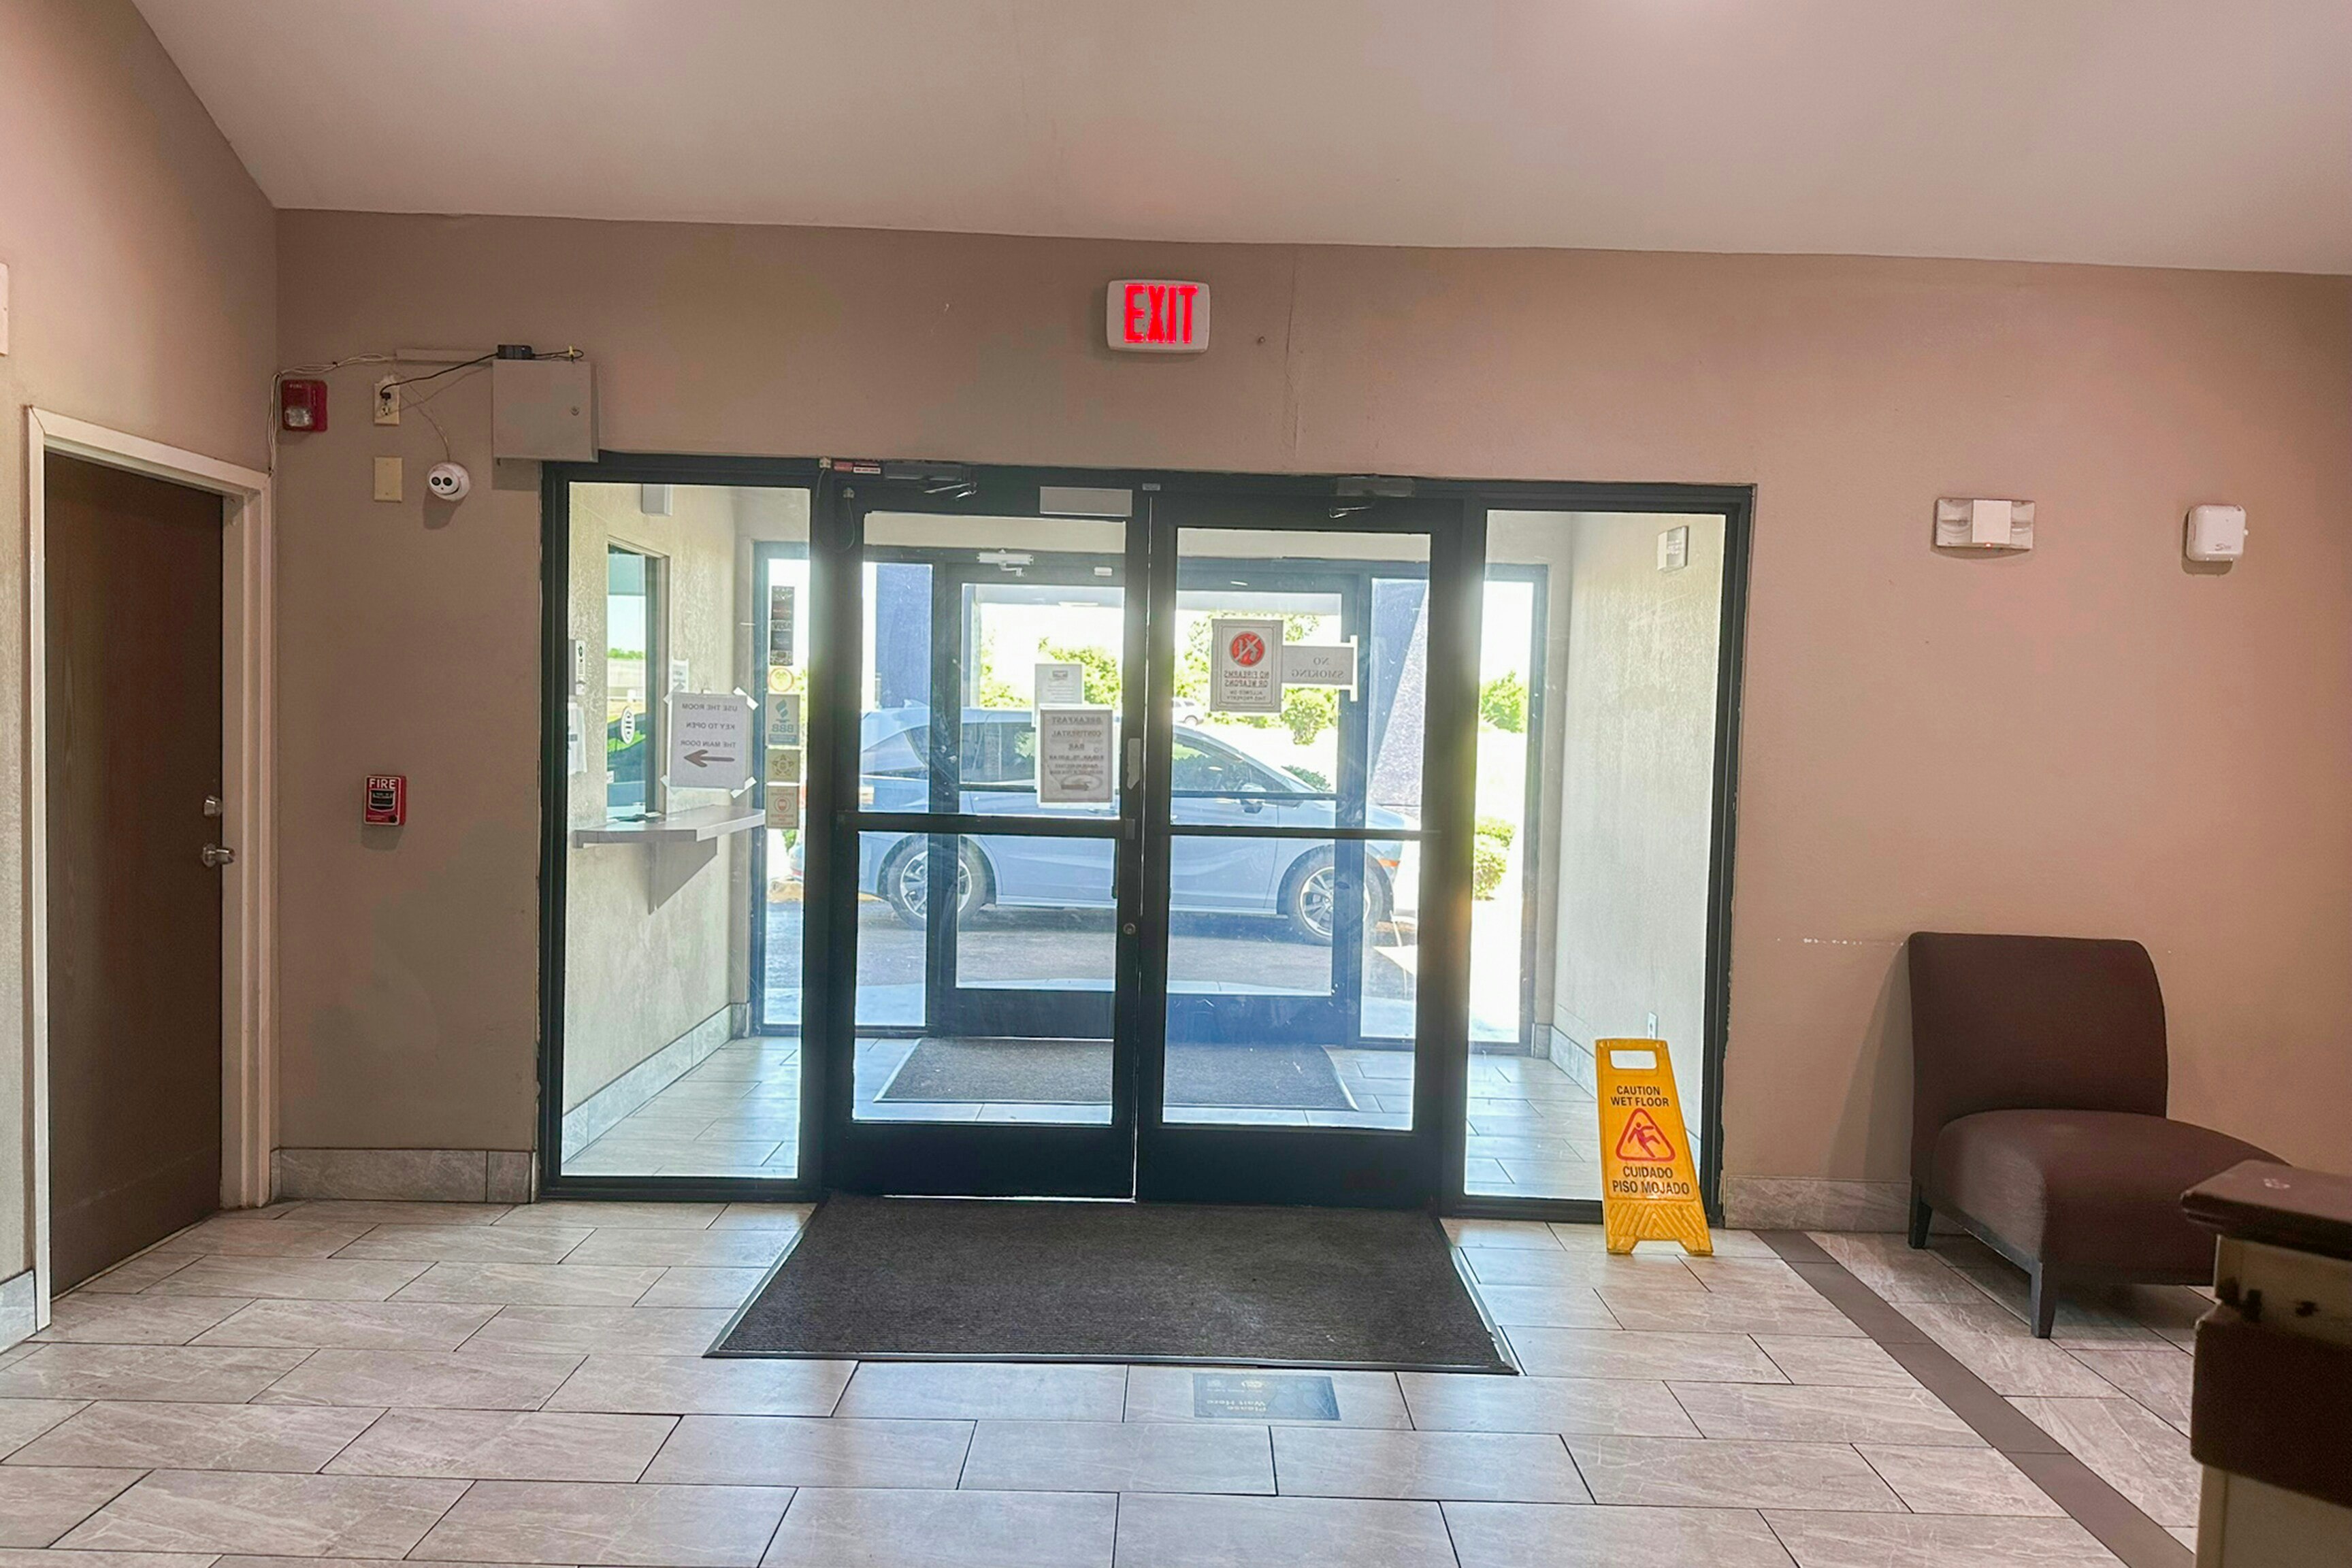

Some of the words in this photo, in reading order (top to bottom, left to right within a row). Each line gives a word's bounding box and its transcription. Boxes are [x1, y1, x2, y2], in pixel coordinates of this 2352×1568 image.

[1124, 283, 1198, 344] EXIT
[369, 778, 396, 789] FIRE
[1616, 1085, 1661, 1096] CAUTION
[1610, 1096, 1633, 1106] WET
[1635, 1097, 1669, 1107] FLOOR
[1623, 1165, 1673, 1179] CUIDADO
[1612, 1180, 1638, 1193] PISO
[1641, 1181, 1690, 1195] MOJADO
